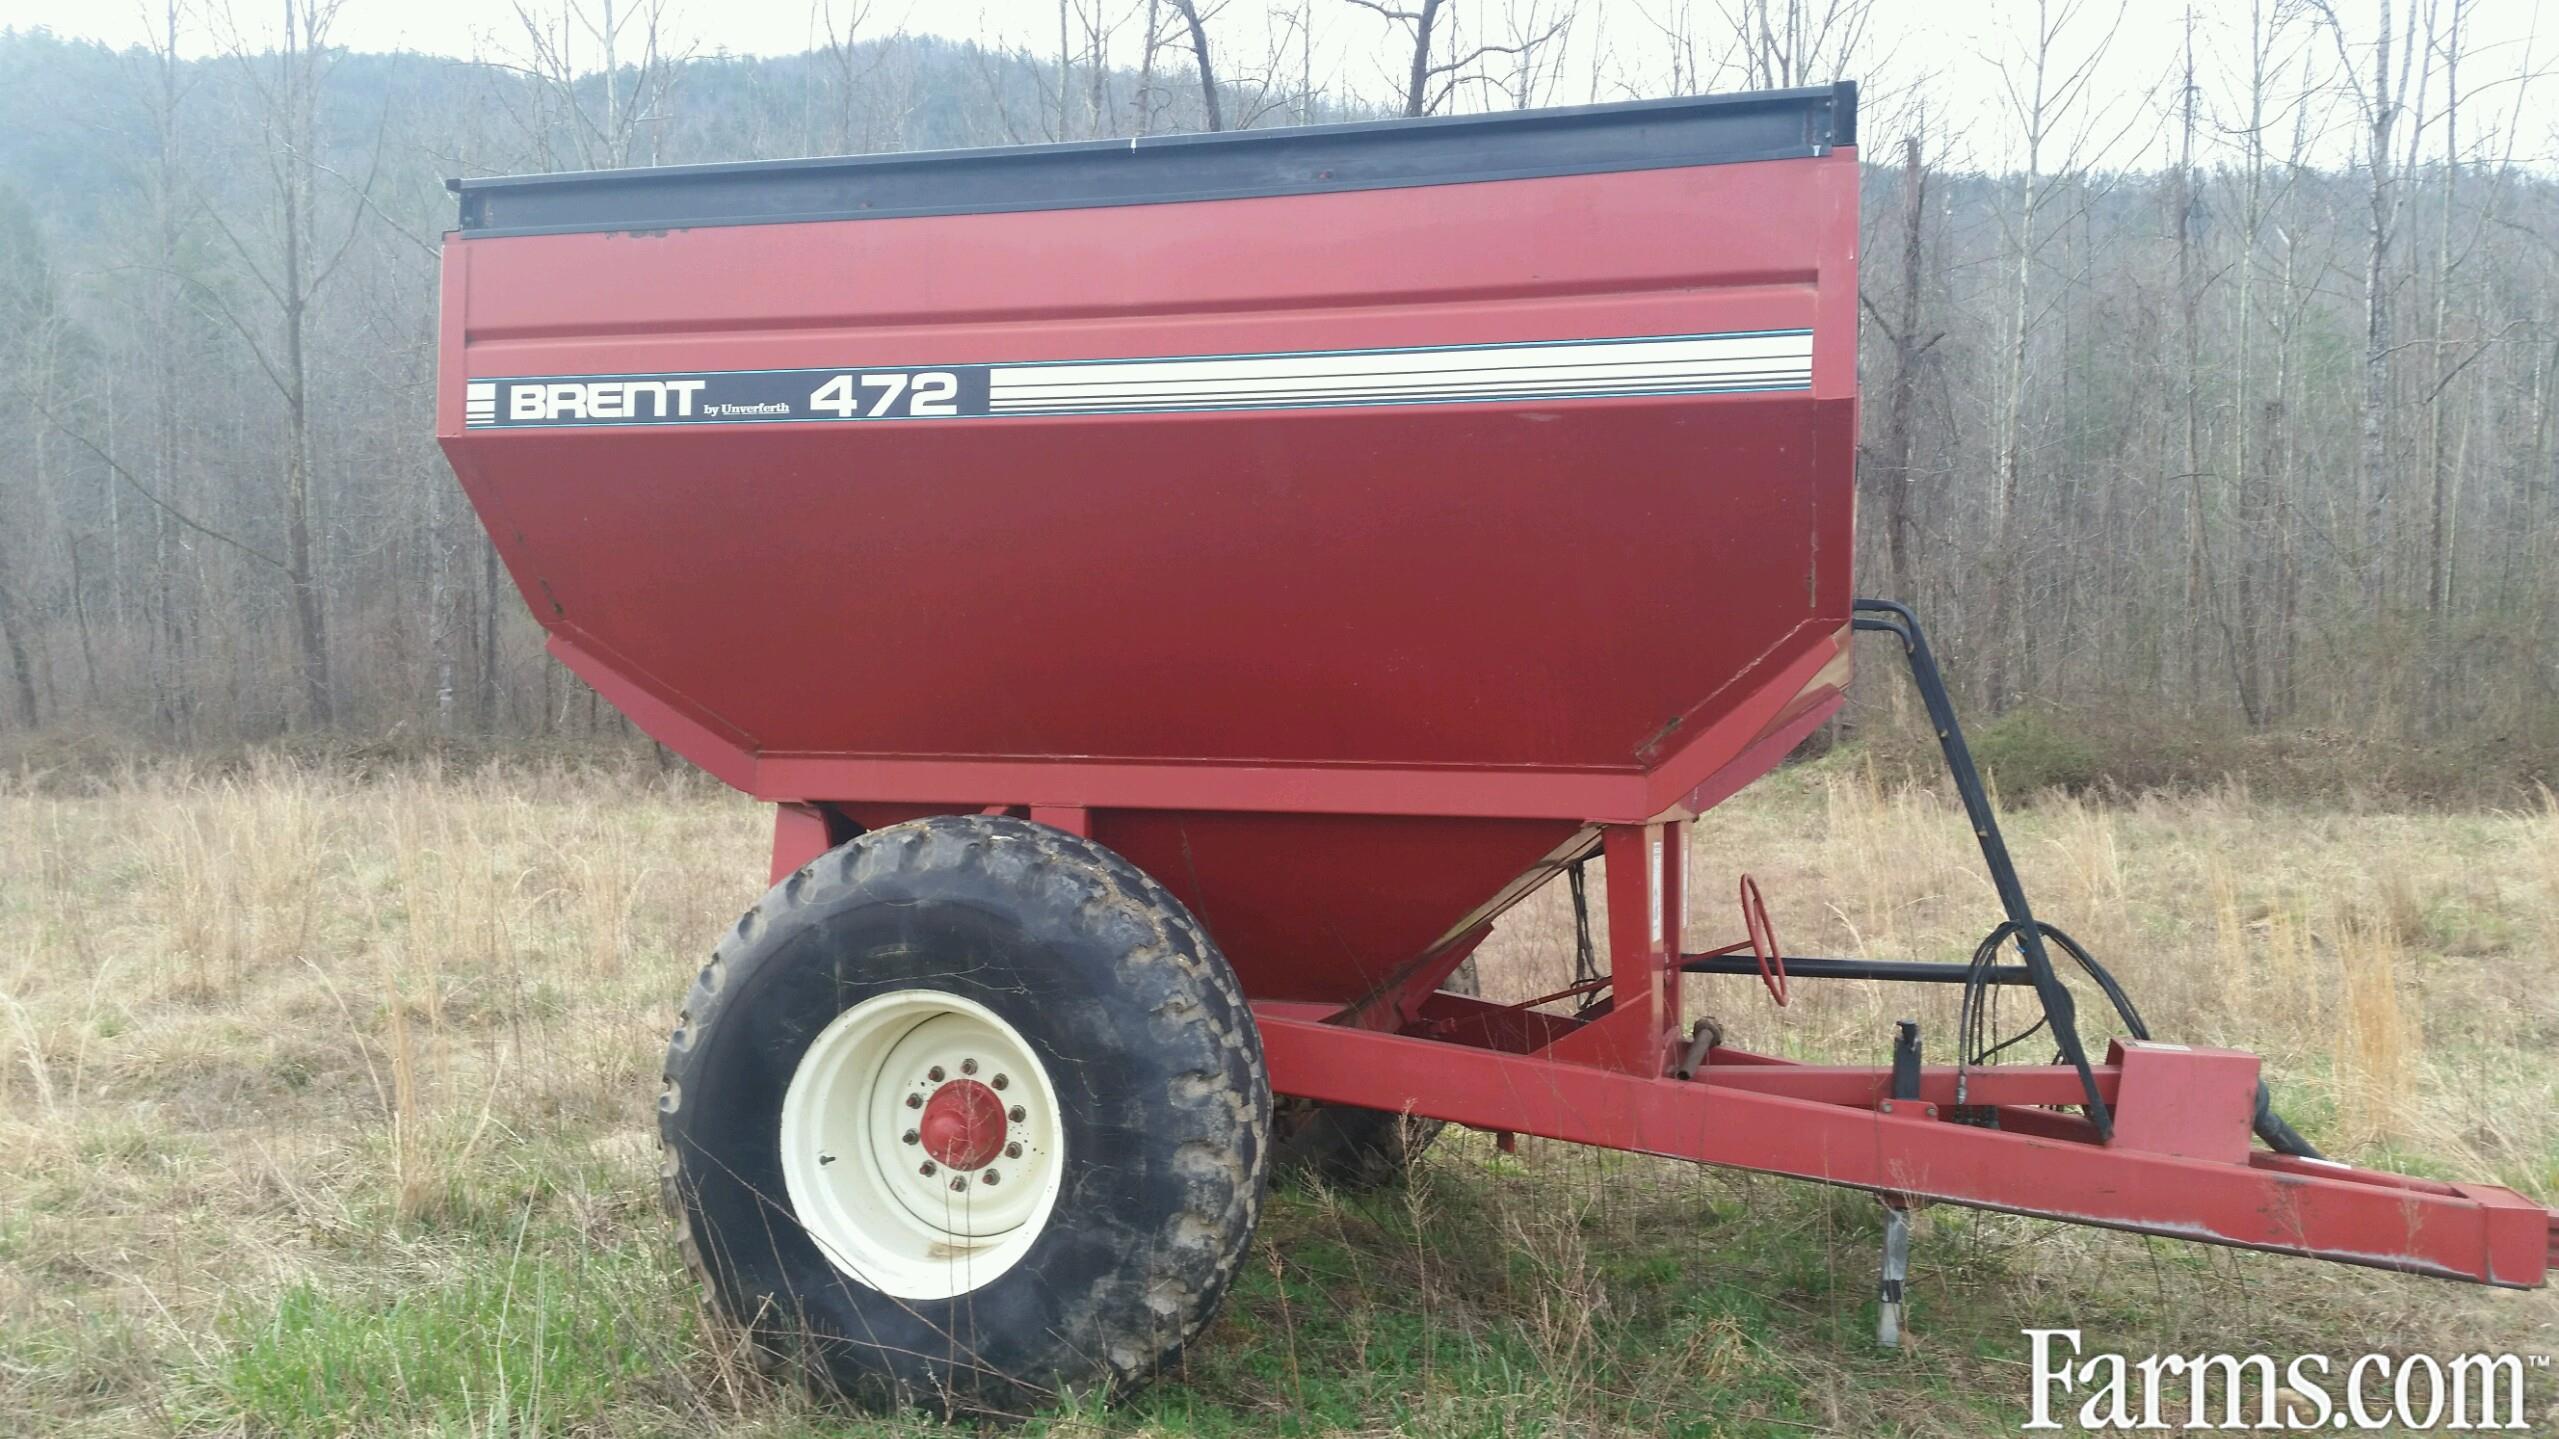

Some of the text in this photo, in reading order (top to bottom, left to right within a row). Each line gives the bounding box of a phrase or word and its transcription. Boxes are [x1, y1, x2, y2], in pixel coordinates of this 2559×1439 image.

[509, 372, 958, 420] BRENT by Unverferth 472
